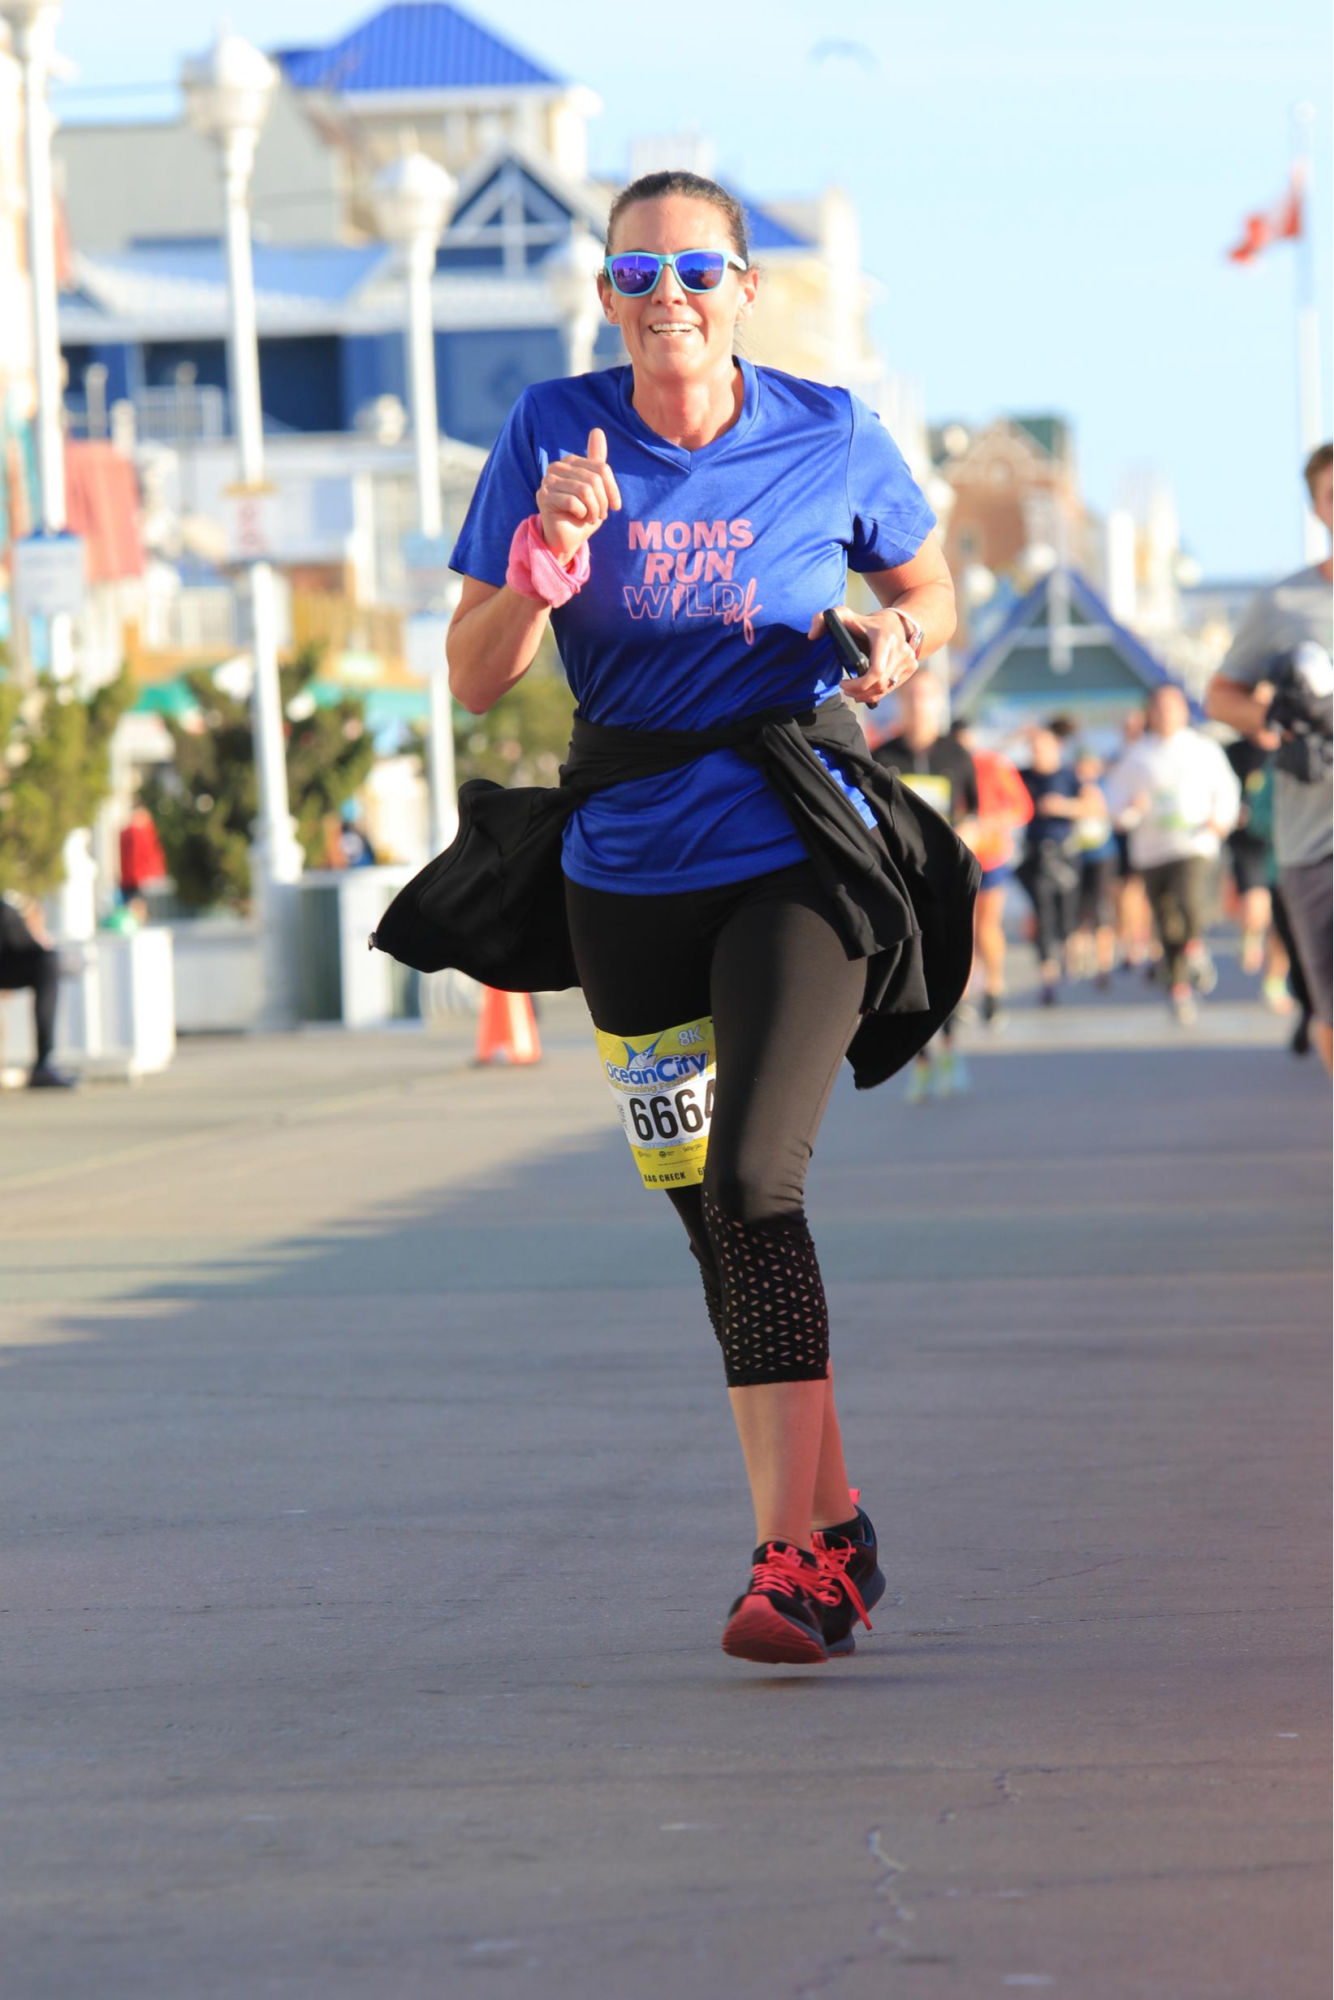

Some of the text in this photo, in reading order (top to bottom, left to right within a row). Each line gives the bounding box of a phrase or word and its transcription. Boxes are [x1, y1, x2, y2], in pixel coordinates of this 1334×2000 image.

[629, 520, 754, 550] MOMS
[644, 550, 736, 585] RUN
[623, 582, 745, 620] WILD
[678, 1025, 705, 1046] 8K
[659, 1172, 686, 1182] CHECK
